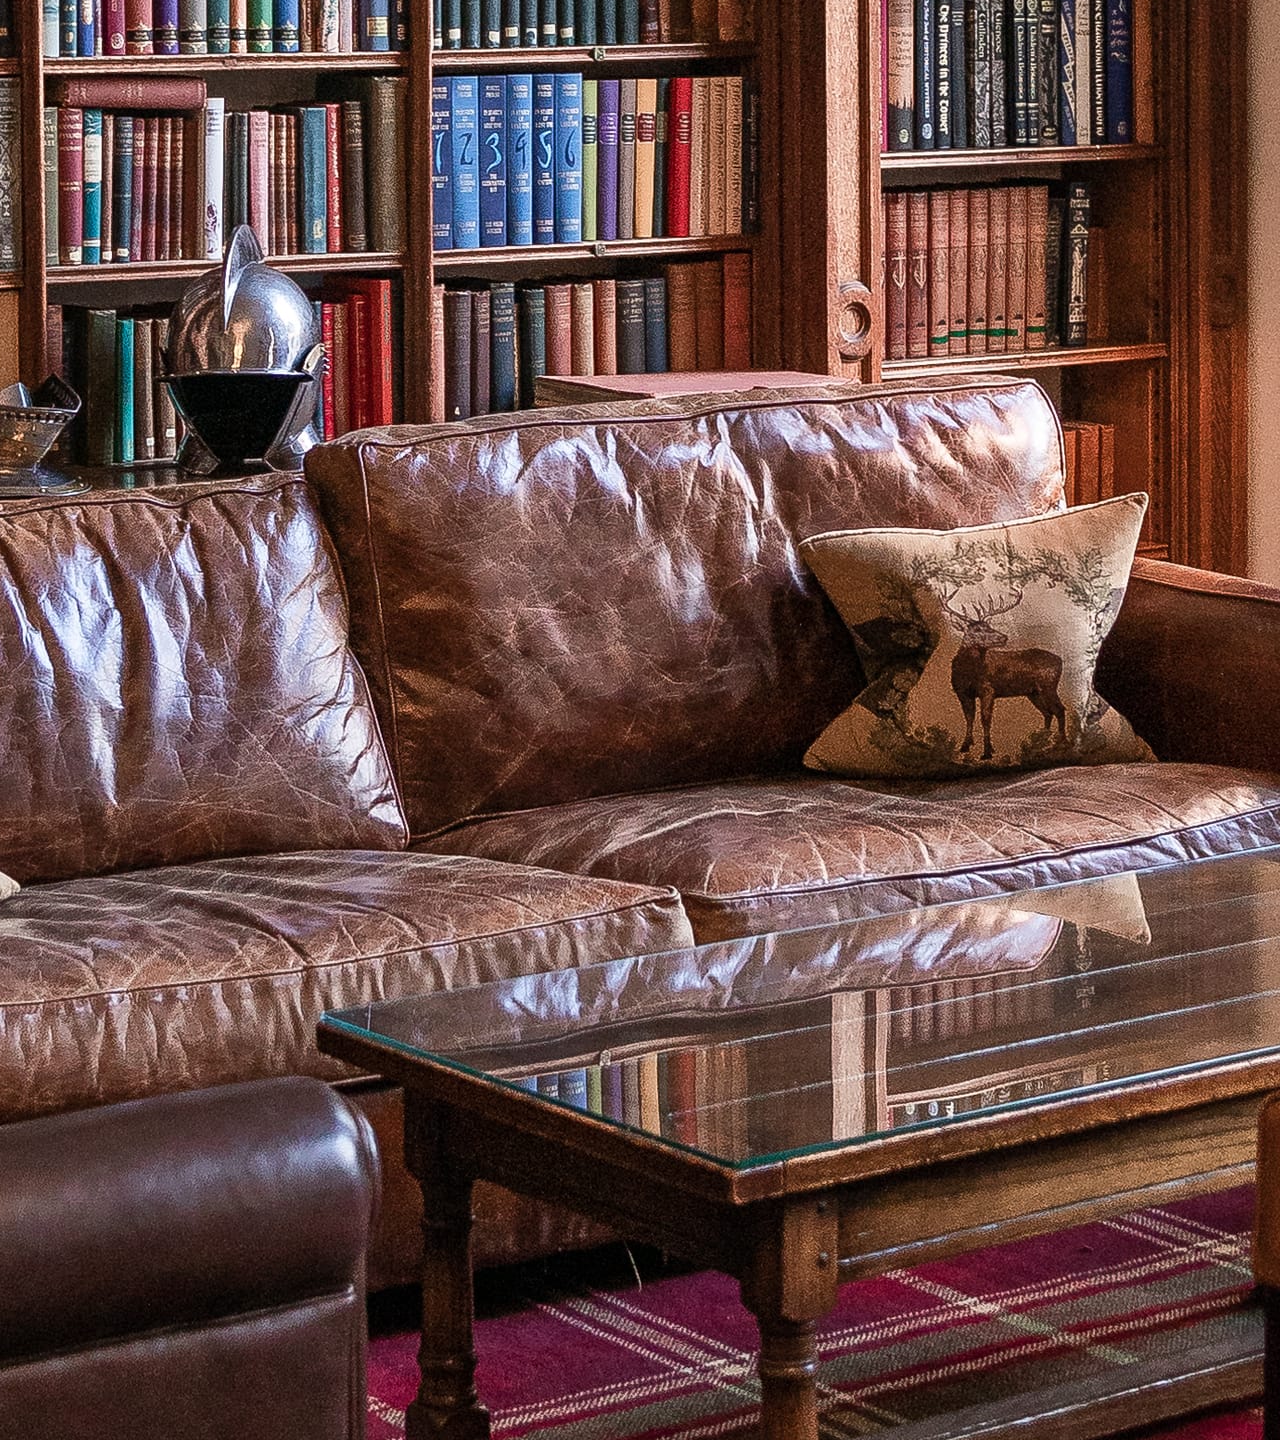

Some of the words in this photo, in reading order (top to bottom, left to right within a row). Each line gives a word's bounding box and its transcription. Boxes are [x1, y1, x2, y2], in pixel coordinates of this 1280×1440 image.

[938, 4, 950, 22] The
[978, 12, 987, 58] Culloden
[434, 131, 445, 174] 1
[458, 132, 473, 166] 2
[484, 132, 502, 174] 3
[515, 131, 528, 170] 4
[536, 130, 552, 169] 5
[564, 129, 576, 168] 6
